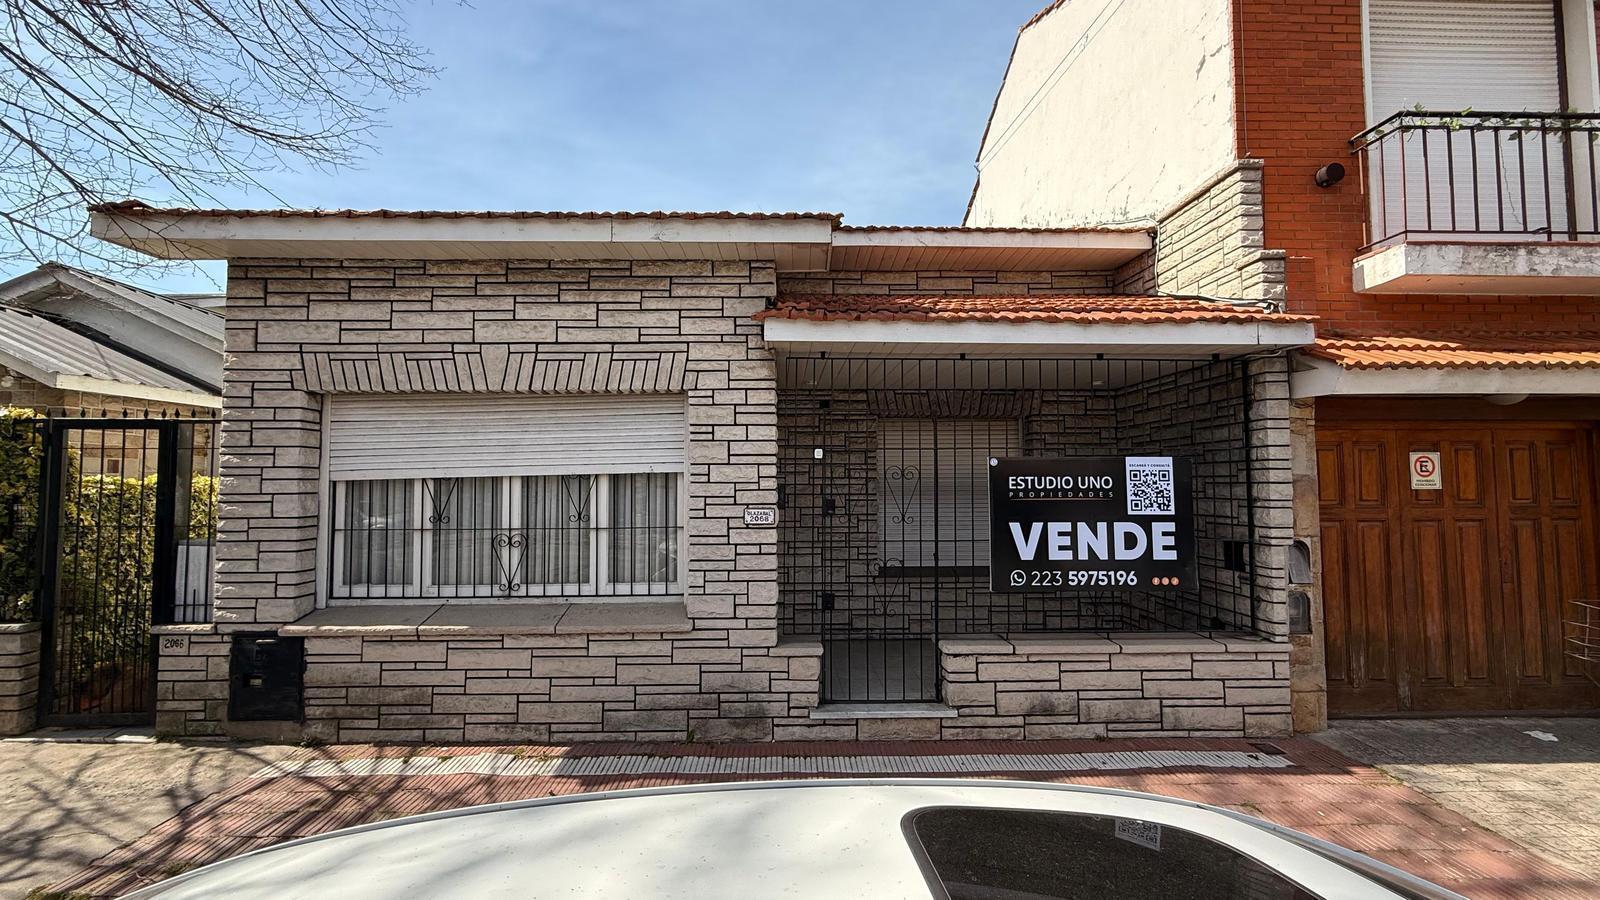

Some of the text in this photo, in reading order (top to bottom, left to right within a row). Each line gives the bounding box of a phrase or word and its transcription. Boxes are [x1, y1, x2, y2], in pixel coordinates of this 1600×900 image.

[1419, 460, 1430, 472] E
[1008, 476, 1113, 489] ESTUDIO UNO
[1008, 521, 1178, 561] VENDE
[1031, 570, 1138, 586] 223 5975196
[164, 638, 184, 649] 2066
